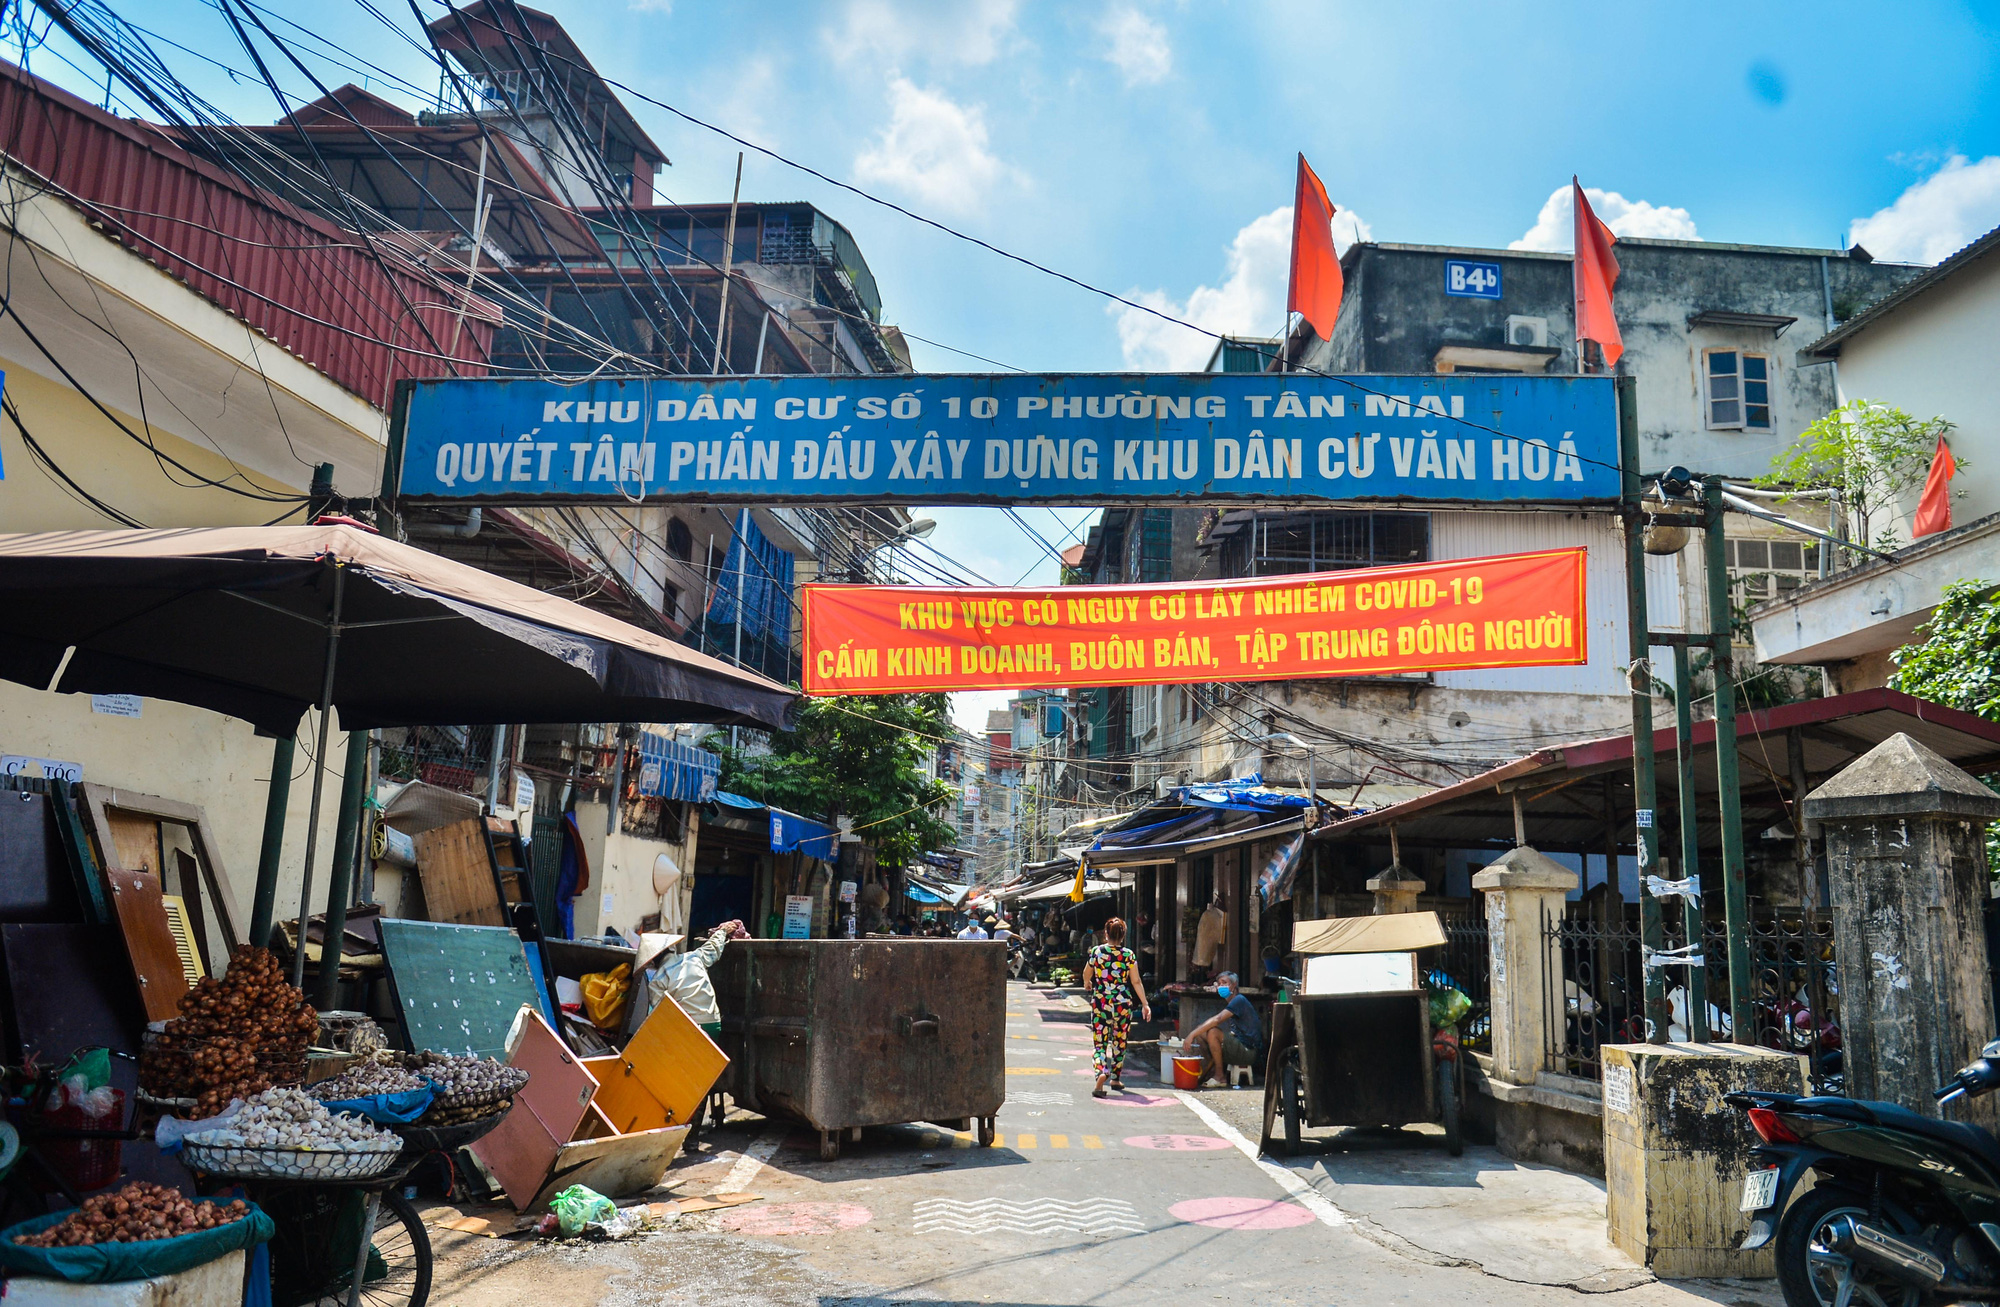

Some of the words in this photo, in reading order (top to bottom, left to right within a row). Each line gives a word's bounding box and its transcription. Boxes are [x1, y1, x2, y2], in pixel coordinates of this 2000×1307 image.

[1451, 265, 1496, 292] B4b
[543, 400, 640, 423] KHU
[657, 392, 757, 422] DÂN
[774, 395, 846, 420] CƯ
[856, 388, 923, 420] SỐ
[941, 397, 999, 419] 10
[1018, 390, 1226, 419] PHƯỜNG
[1244, 390, 1345, 418] TÂN
[1365, 394, 1464, 419] MAI
[436, 428, 558, 487] QUYẾT
[569, 433, 657, 482] TÂM
[668, 425, 780, 481] PHẤN
[791, 425, 876, 480] ĐẤU
[888, 430, 970, 479] XÂY
[984, 435, 1098, 488] DỰNG
[1113, 440, 1198, 481] KHU
[1214, 429, 1302, 479] DÂN
[1318, 432, 1381, 480] CƯ
[1389, 429, 1476, 480] VĂN
[1491, 431, 1584, 482] HOÁ
[899, 601, 953, 630] KHU
[960, 597, 1015, 635] VỰC
[1022, 593, 1059, 627] CÓ
[1066, 596, 1140, 625] NGUY
[1149, 591, 1187, 621] CƠ
[1194, 587, 1245, 619] LÂY
[1354, 575, 1484, 612] COVID-19
[816, 638, 879, 680] CẤM
[887, 645, 952, 677] KINH
[960, 642, 1062, 676] DOANH,
[1069, 633, 1146, 671] BUÔN
[1153, 630, 1220, 669] BÁN,
[1234, 627, 1288, 670] TẬP
[1295, 627, 1389, 662] TRUNG
[1396, 618, 1476, 656] ĐÔNG
[1483, 610, 1573, 652] NGƯỜI
[44, 763, 76, 782] TÓC
[1748, 1172, 1774, 1191] 30-K7
[1745, 1190, 1769, 1207] 1788
